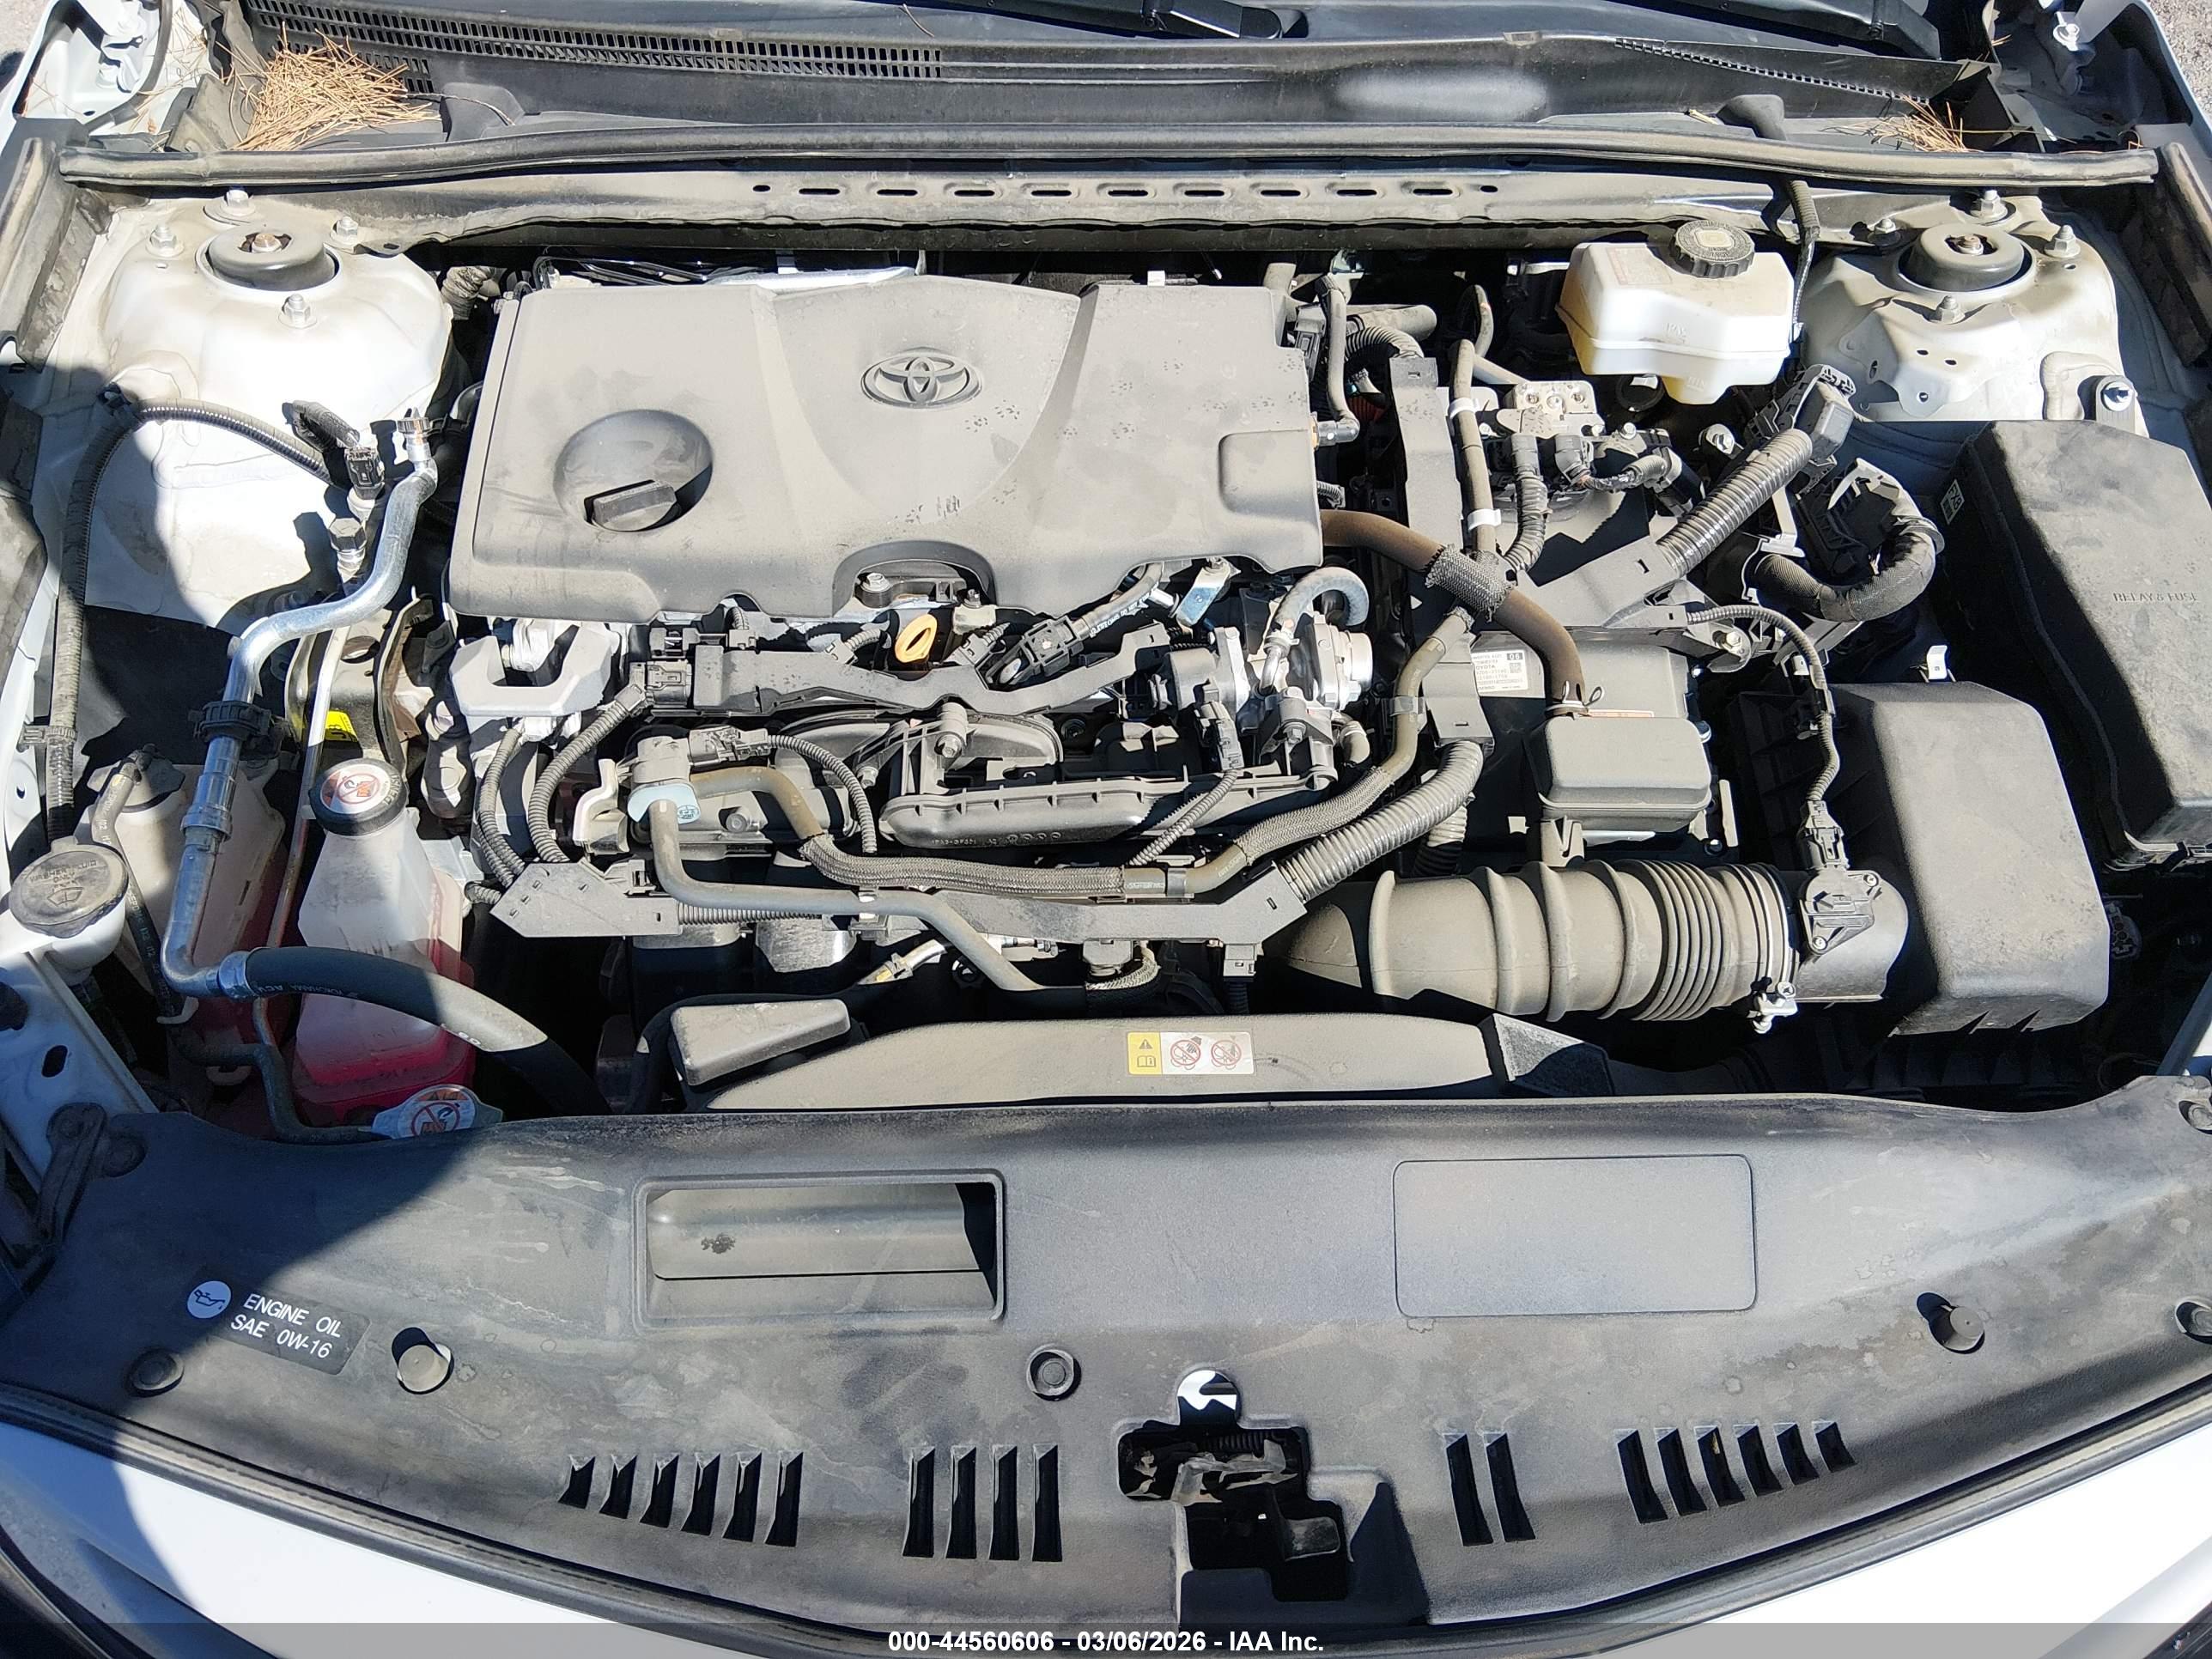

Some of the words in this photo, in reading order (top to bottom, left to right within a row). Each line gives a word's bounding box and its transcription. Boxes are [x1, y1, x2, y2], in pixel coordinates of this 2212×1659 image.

[2112, 592, 2153, 602] RELAY
[2167, 592, 2197, 602] FUSE
[230, 1314, 270, 1339] SAE
[276, 1328, 333, 1358] 0W-16
[243, 1293, 310, 1326] ENGINE
[315, 1316, 343, 1338] OIL
